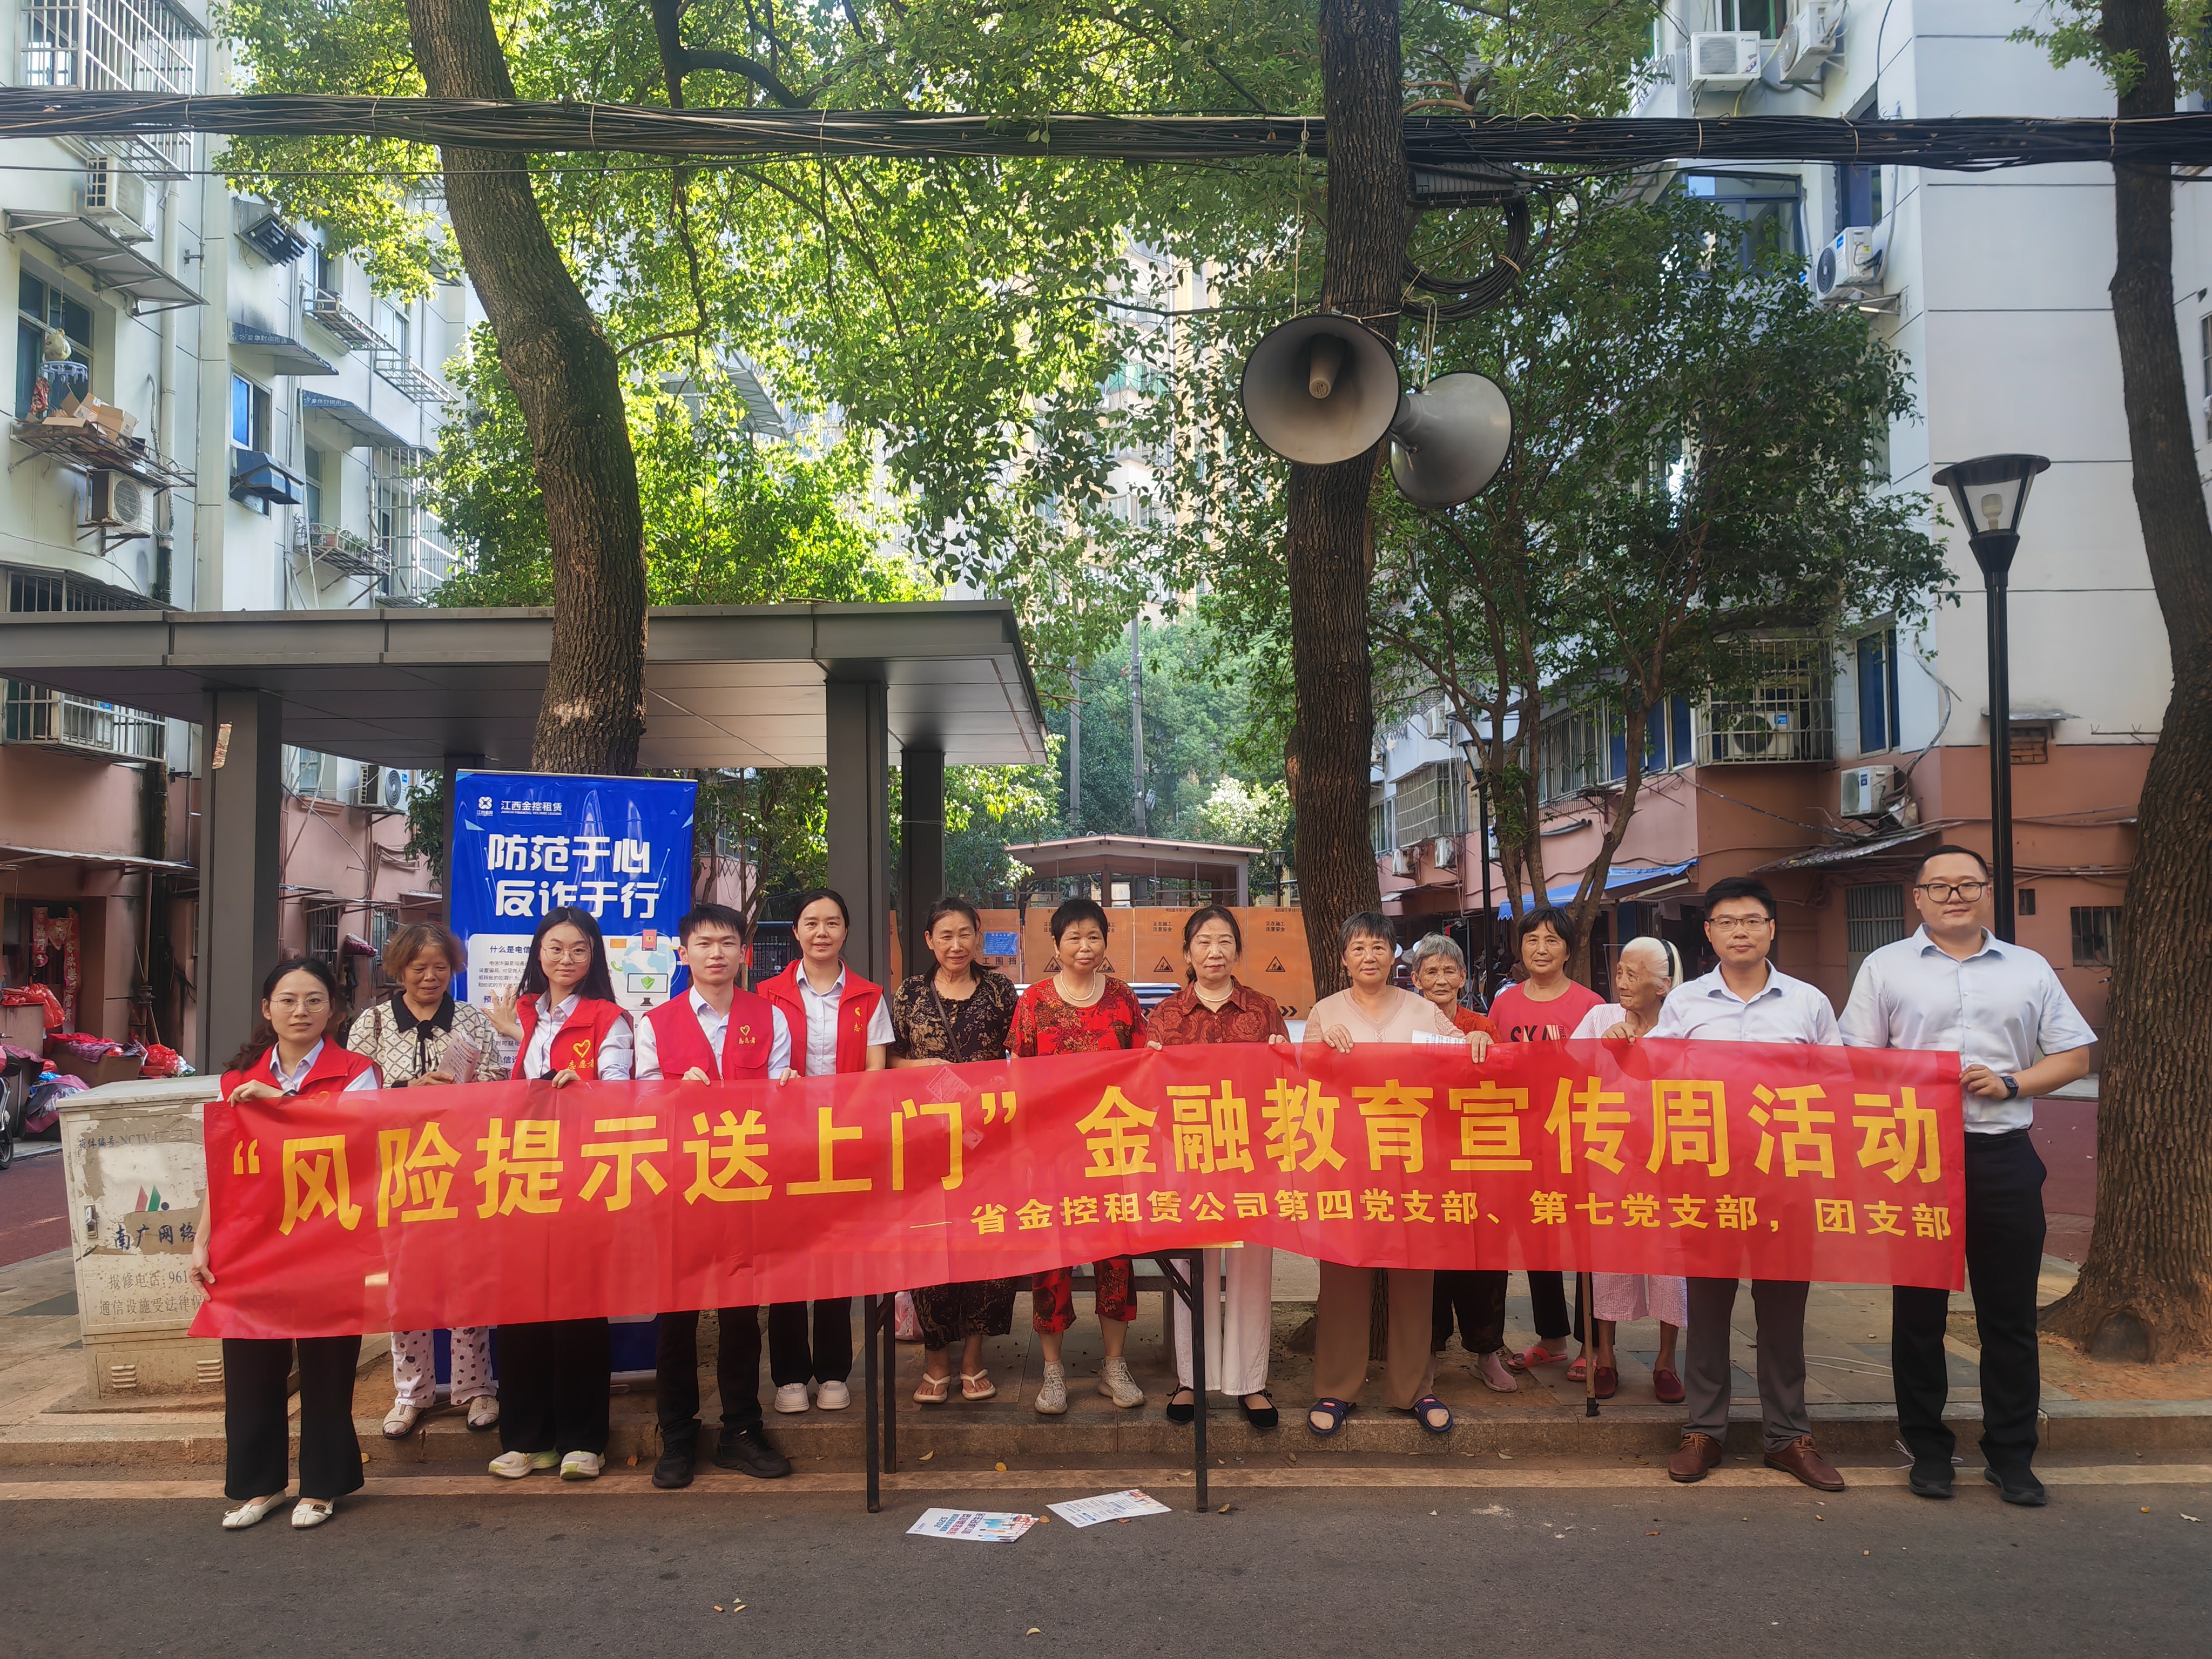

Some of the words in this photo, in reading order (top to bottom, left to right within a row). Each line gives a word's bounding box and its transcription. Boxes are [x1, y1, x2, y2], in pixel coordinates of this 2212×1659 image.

[500, 800, 563, 812] 江西金控租赁
[487, 834, 650, 873] 防范于心
[495, 880, 659, 919] 反诈于行
[568, 1058, 594, 1070] 志愿者
[1075, 1076, 1941, 1184] 金融教育宣传周活动
[114, 1222, 197, 1250] 南广网络
[934, 1516, 948, 1528] 2025
